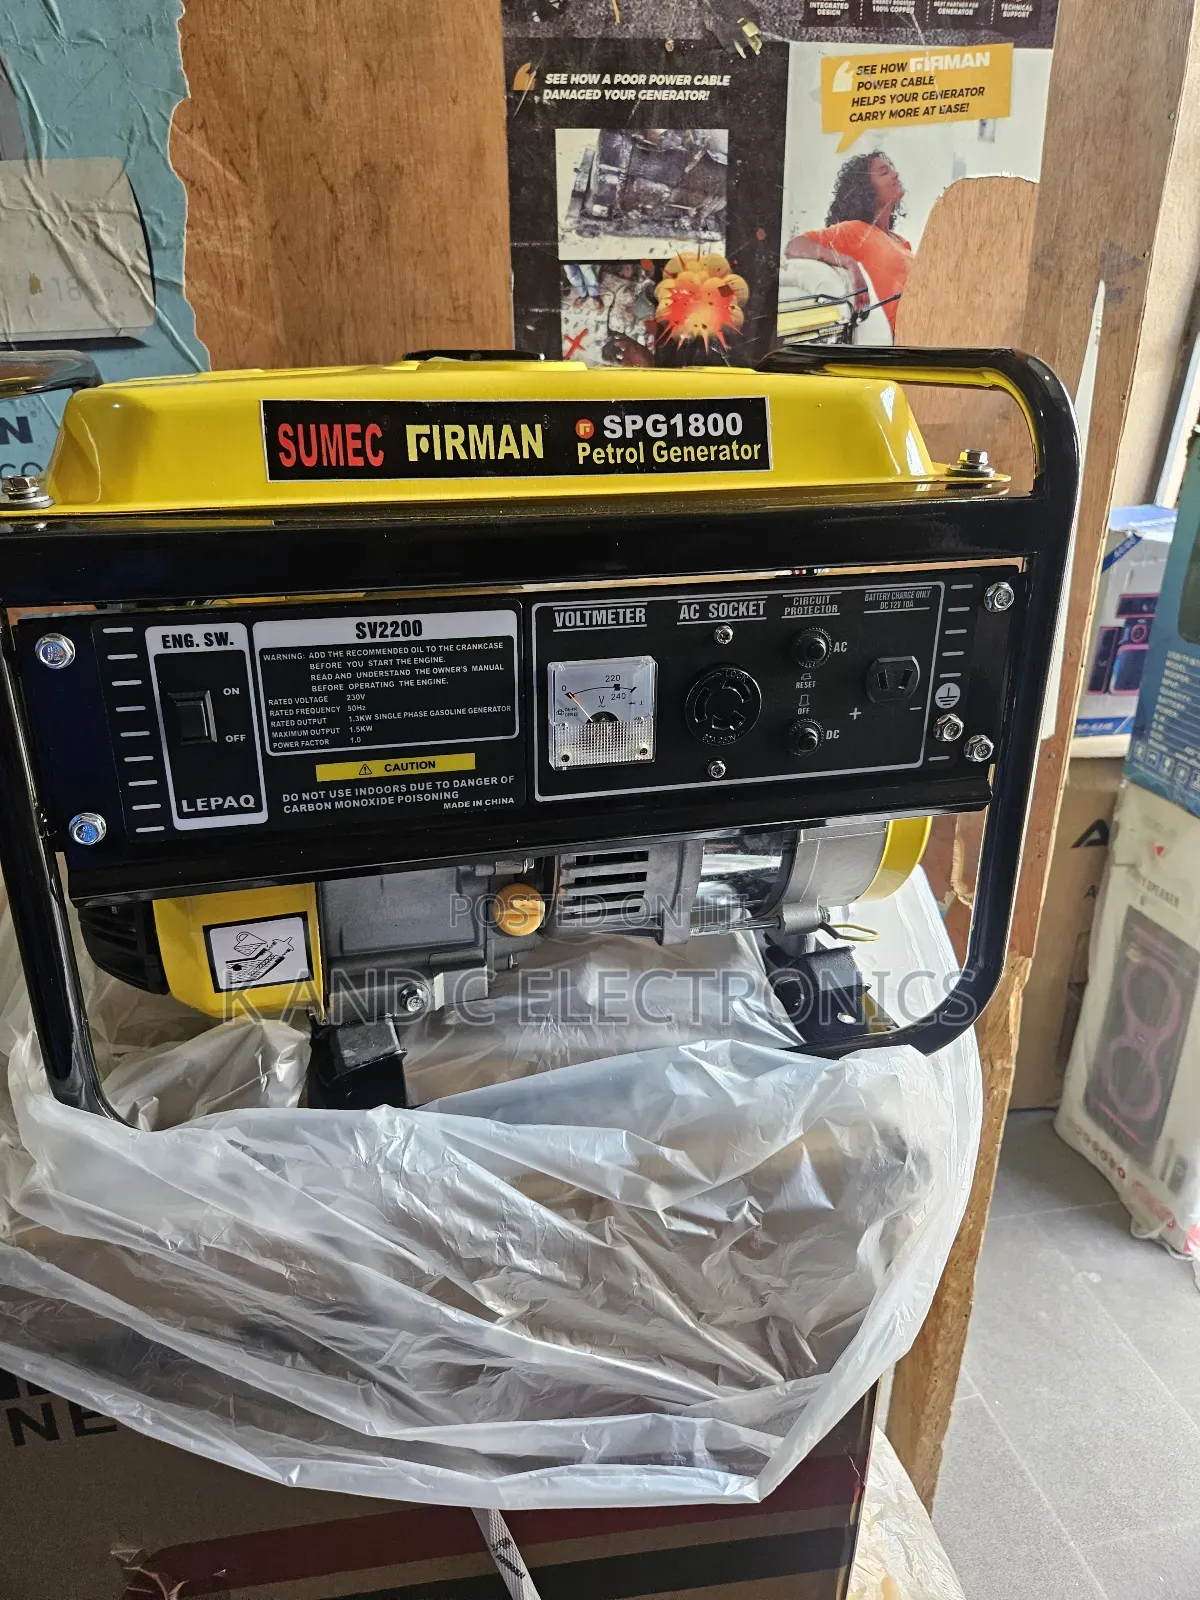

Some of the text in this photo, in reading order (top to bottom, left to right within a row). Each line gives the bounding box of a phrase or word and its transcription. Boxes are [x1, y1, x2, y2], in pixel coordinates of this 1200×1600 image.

[810, 1, 849, 9] INTEGRATED
[1001, 3, 1033, 11] TECHNICAL
[938, 8, 974, 16] GENERATOR
[1002, 10, 1030, 18] SUPPORT
[856, 51, 991, 76] SEE HOW FIRMAN
[545, 74, 731, 86] SEE HOW A POOR POWER CABLE
[857, 75, 936, 92] POWER CABLE
[543, 89, 711, 101] DAMAGED YOUR GENERATOR!
[852, 87, 985, 107] HELPS YOUR GENERATOR
[849, 103, 970, 122] CARRY MORE AT EASE!
[603, 413, 743, 439] SPG1800
[278, 423, 544, 467] SUMEC FIRMAN
[577, 440, 762, 465] Petrol Generator
[793, 595, 831, 606] CIRCUIT
[864, 590, 931, 602] BATTERY CHARGE ONLY
[679, 600, 766, 620] AC SOCKET
[784, 604, 838, 616] PROTECTOR
[880, 601, 889, 610] DC
[890, 600, 902, 609] 12V
[554, 607, 646, 627] VOLTMETER
[355, 620, 423, 639] SV2200
[162, 632, 235, 649] ENG. SW.
[834, 641, 848, 653] AC
[263, 653, 305, 661] WARNING:
[309, 651, 326, 659] ADD
[327, 650, 344, 658] THE
[346, 647, 409, 657] RECOMMENDED
[426, 645, 437, 653] TO
[438, 644, 454, 652] THE
[456, 642, 504, 651] CRANKCASE
[309, 662, 342, 670] BEFORE
[368, 658, 394, 667] START
[413, 656, 446, 665] ENGINE.
[310, 673, 333, 681] READ
[335, 672, 352, 680] AND
[356, 669, 411, 679] UNDERSTAND
[432, 665, 468, 674] OWNER'S
[471, 663, 504, 672] MANUAL
[605, 674, 621, 683] 220
[311, 677, 449, 692] BEFORE OPERATING THE ENGINE.
[795, 680, 816, 689] RESET
[223, 687, 240, 696] ON
[611, 692, 626, 701] 240
[268, 693, 366, 706] RATED VOLTAGE 230V
[269, 708, 294, 717] RATED
[295, 706, 341, 715] FREQUENCY
[270, 720, 295, 728] RATED
[296, 717, 328, 726] OUTPUT
[374, 712, 402, 721] SINGLE
[403, 711, 428, 719] PHASE
[429, 708, 467, 717] GASOLINE
[468, 705, 512, 714] GENERATOR
[797, 707, 810, 715] OFF
[272, 725, 373, 738] MAXIMUM OUTPUT 1.5KW
[826, 730, 840, 739] DC
[225, 734, 247, 743] OFF
[273, 736, 362, 749] POWER FACTOR 1.0
[384, 760, 436, 773] CAUTION
[282, 775, 515, 802] DO NOT USE INDOORS DUE TO DANGER OF
[181, 794, 256, 813] LEPAQ
[283, 791, 459, 814] CARBON MONOXIDE POISONING
[443, 797, 515, 809] MADE IN CHINA
